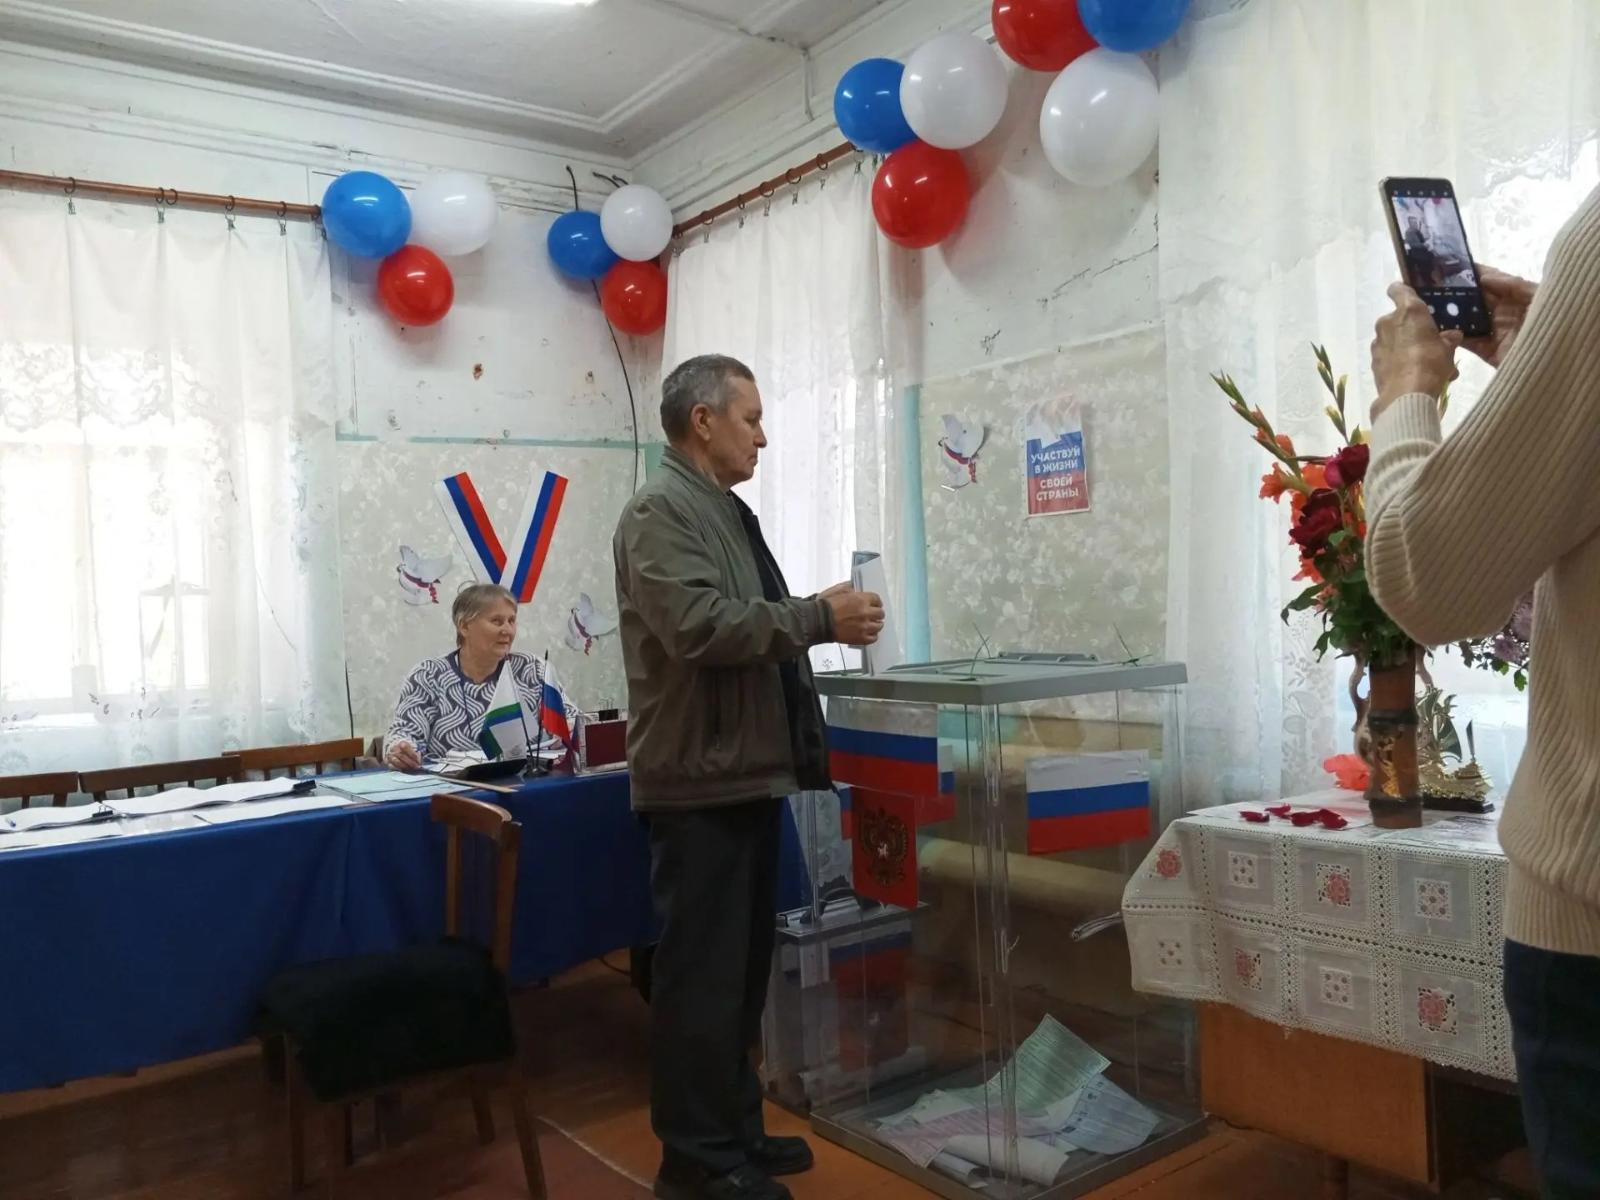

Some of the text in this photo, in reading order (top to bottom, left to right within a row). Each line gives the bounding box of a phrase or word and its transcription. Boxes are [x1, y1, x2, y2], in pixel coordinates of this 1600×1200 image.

[1031, 446, 1080, 463] УЧАСТВУЙ
[1034, 460, 1078, 474] В ЖИЗНИ
[1040, 474, 1073, 489] СВОЕЙ
[1036, 488, 1079, 501] СТРАНЫ
